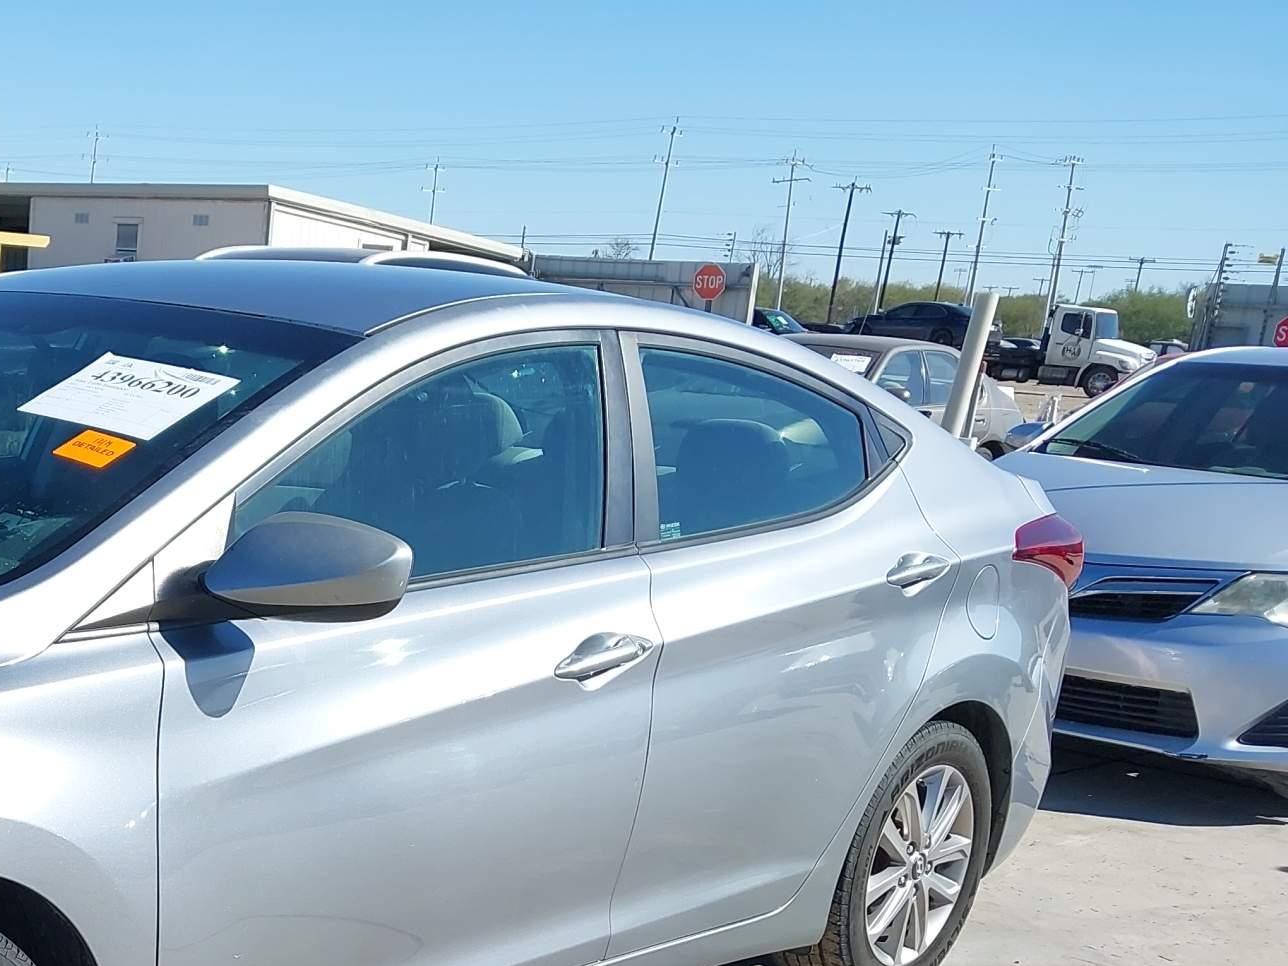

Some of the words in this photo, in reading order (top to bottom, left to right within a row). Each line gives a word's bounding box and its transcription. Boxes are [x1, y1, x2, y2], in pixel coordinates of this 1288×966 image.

[696, 275, 723, 289] STOP
[91, 370, 200, 398] 43966200
[72, 441, 114, 456] DETAILED
